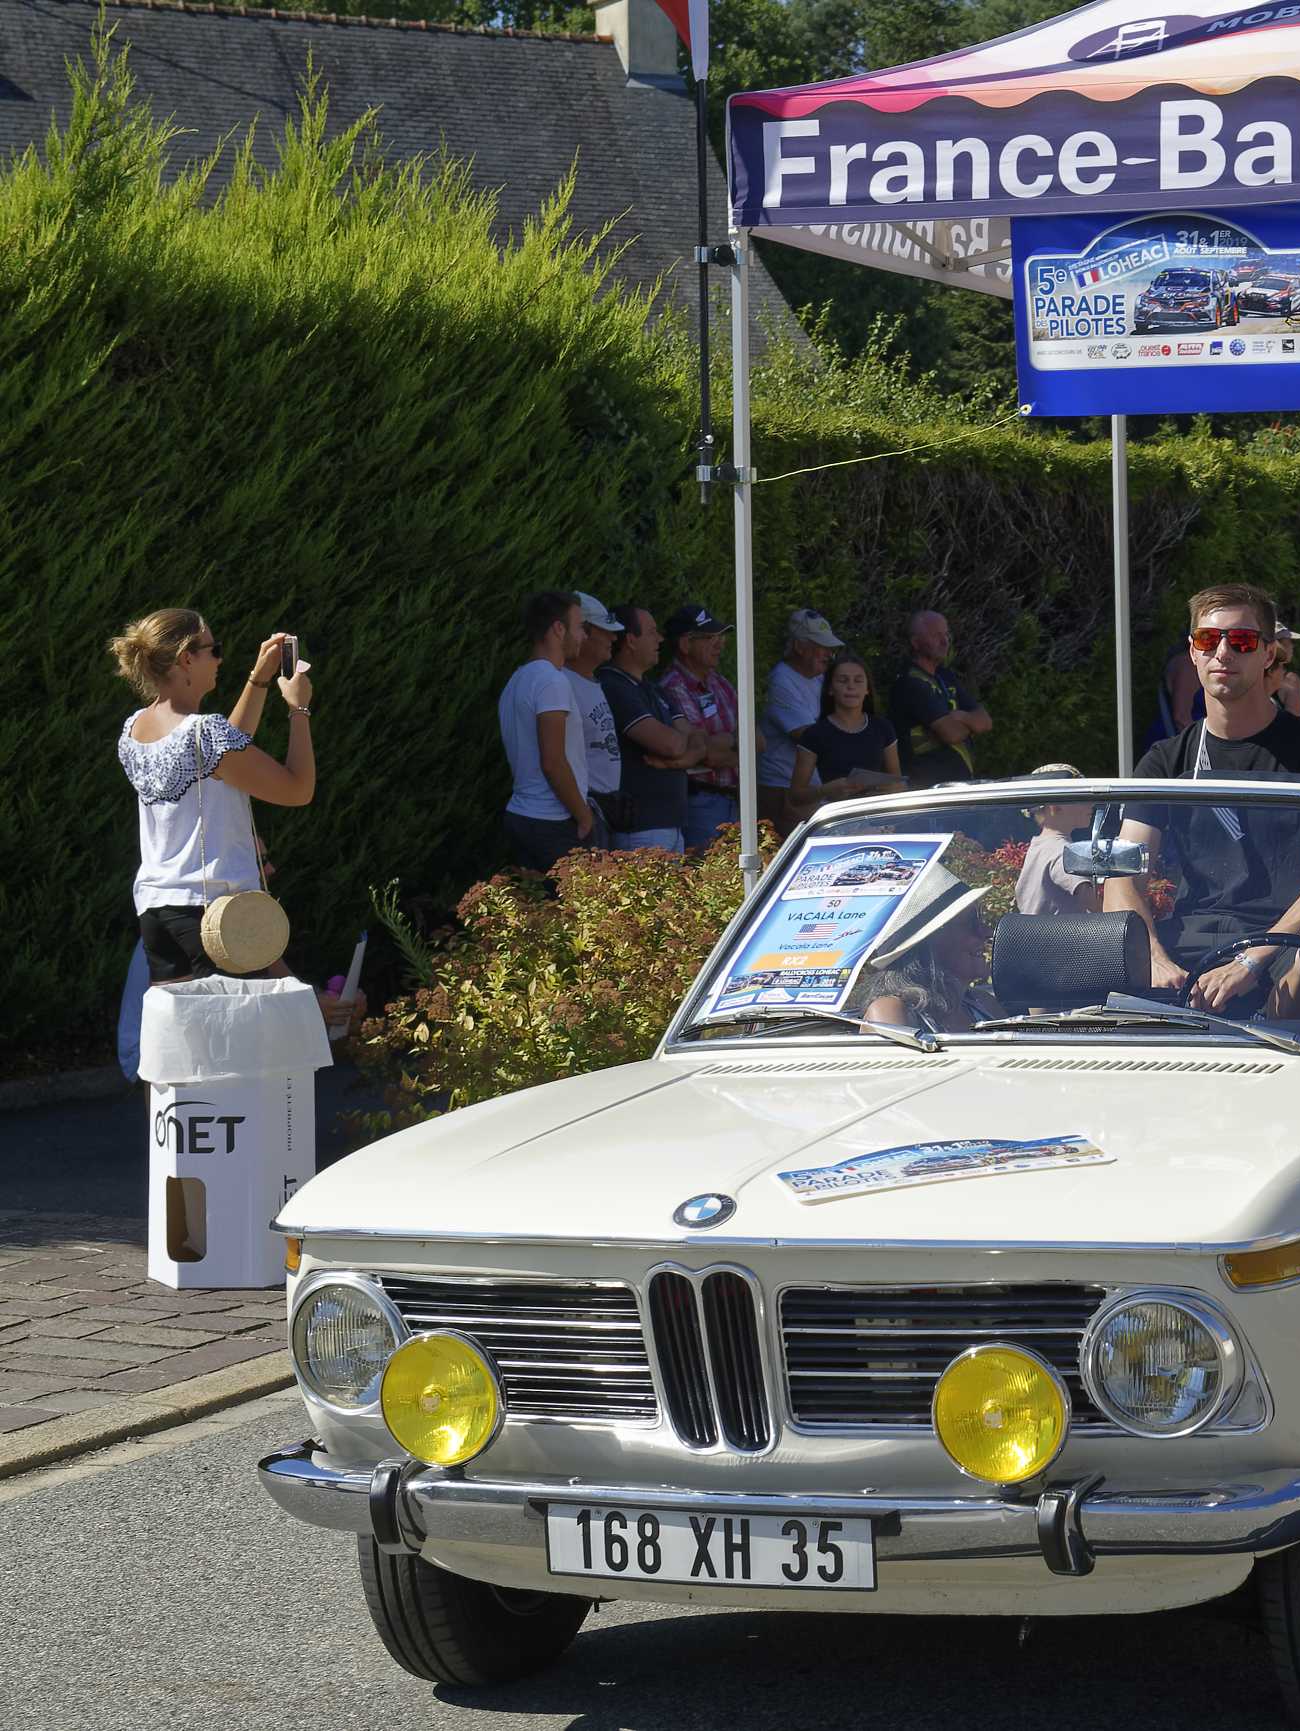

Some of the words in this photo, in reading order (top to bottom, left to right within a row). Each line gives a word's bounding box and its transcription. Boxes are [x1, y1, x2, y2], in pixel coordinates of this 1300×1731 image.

[1176, 230, 1200, 247] 31
[1200, 246, 1248, 255] SEPTEMBRE
[1099, 244, 1163, 279] LOHEAC
[1037, 266, 1067, 295] 5e
[1034, 295, 1126, 318] PARADE
[1050, 317, 1126, 337] PILOTES
[787, 911, 835, 922] VACALA
[838, 910, 867, 921] Lane
[576, 1509, 661, 1574] 168
[688, 1516, 751, 1580] XH
[781, 1520, 844, 1583] 35
